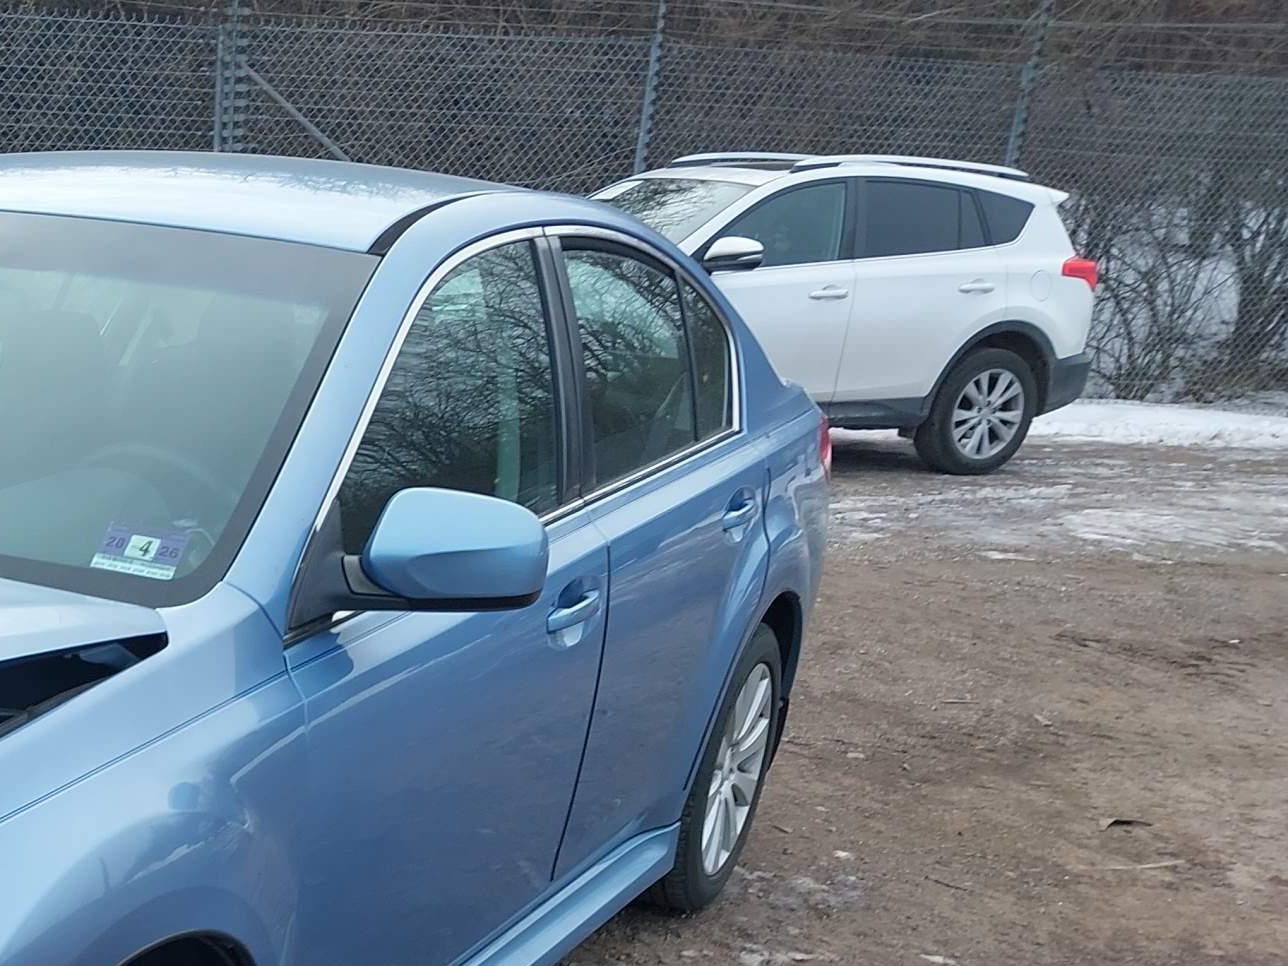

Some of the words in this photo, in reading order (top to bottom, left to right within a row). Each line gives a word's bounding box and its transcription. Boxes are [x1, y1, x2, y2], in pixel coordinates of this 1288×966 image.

[106, 536, 125, 548] 20
[139, 541, 154, 557] 4
[158, 546, 179, 558] 26
